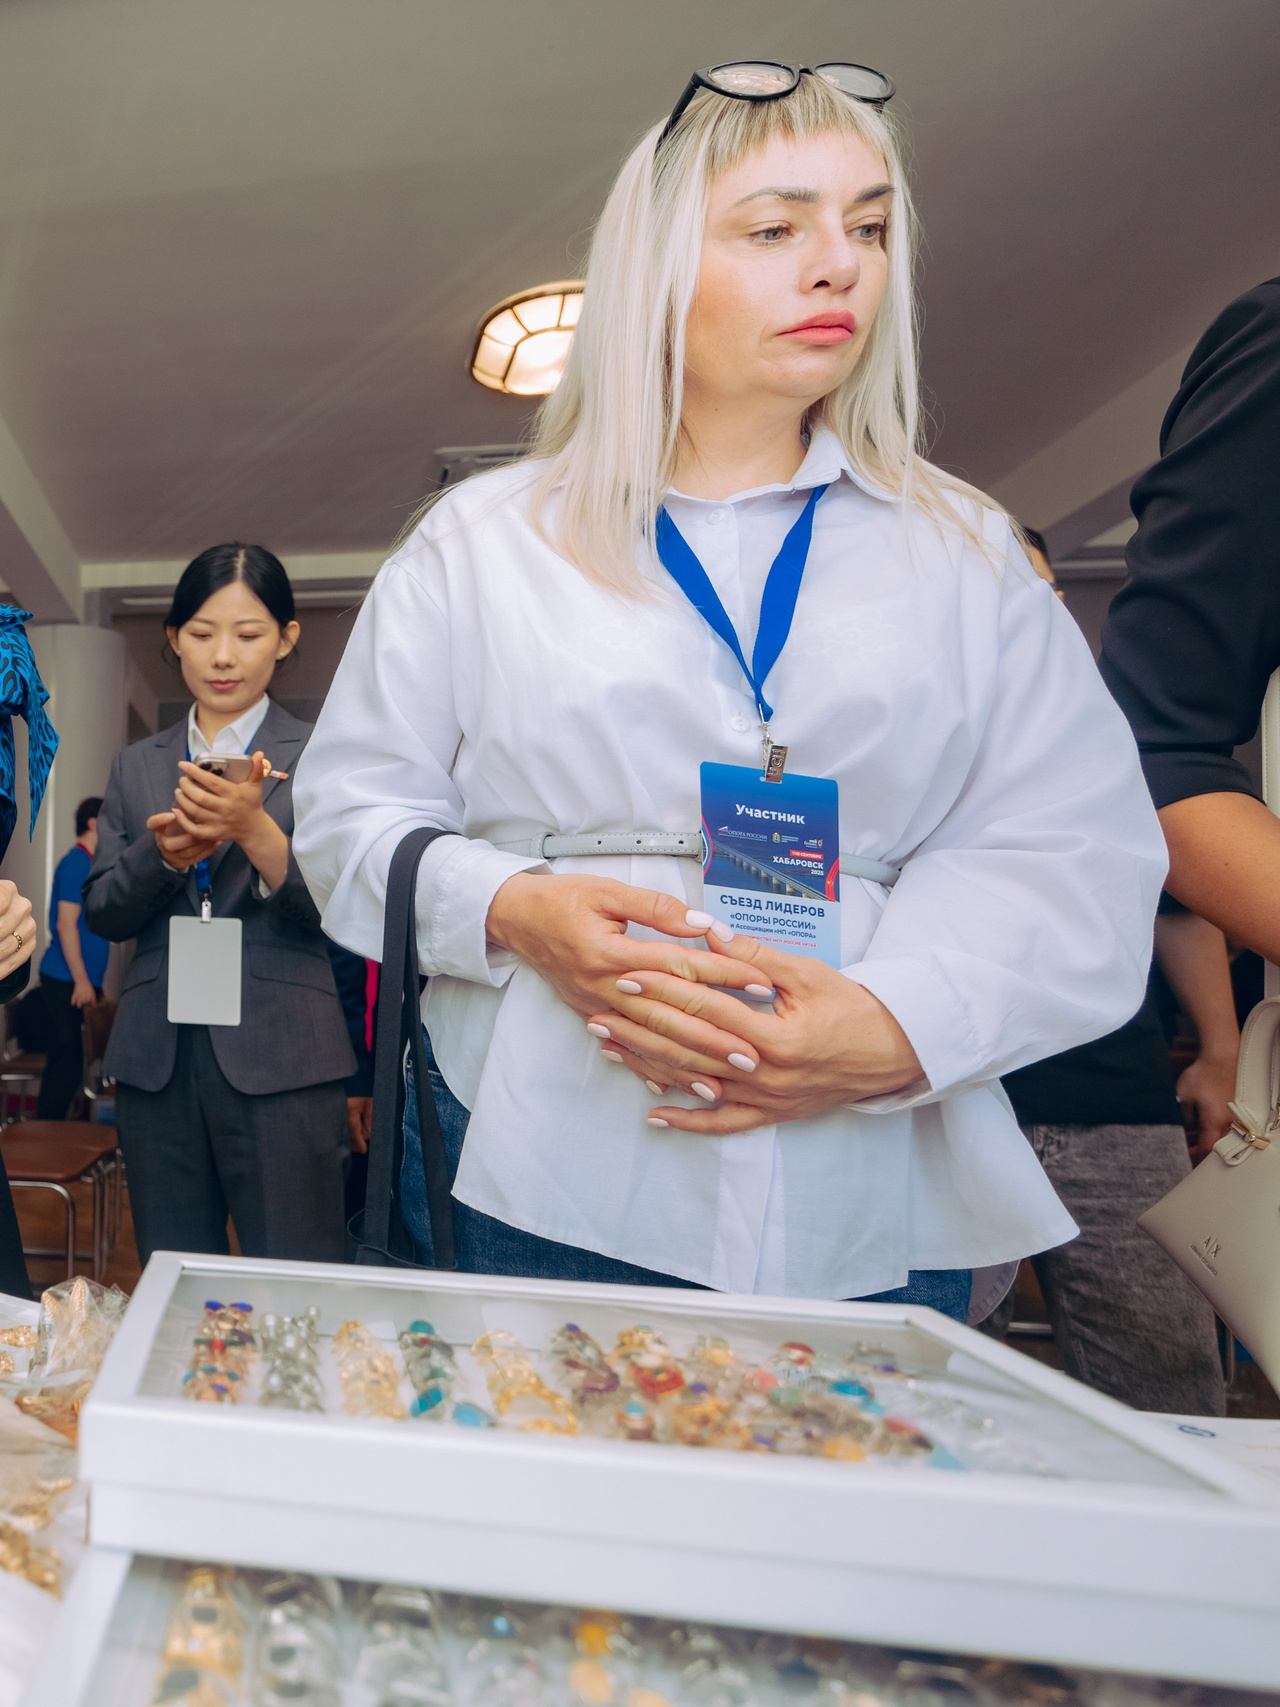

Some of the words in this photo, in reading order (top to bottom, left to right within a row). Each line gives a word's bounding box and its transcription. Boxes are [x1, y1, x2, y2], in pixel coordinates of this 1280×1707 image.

[735, 803, 806, 825] Участник
[772, 855, 824, 869] ХАБАРОВСК
[720, 894, 763, 910] СЪЕЗД
[765, 900, 825, 918] ЛИДЕРОВ
[730, 912, 771, 925] «ОПОРЫ
[772, 917, 817, 930] РОССИИ»
[735, 923, 774, 933] Ассоциации
[787, 930, 817, 939] «ОПОРА»
